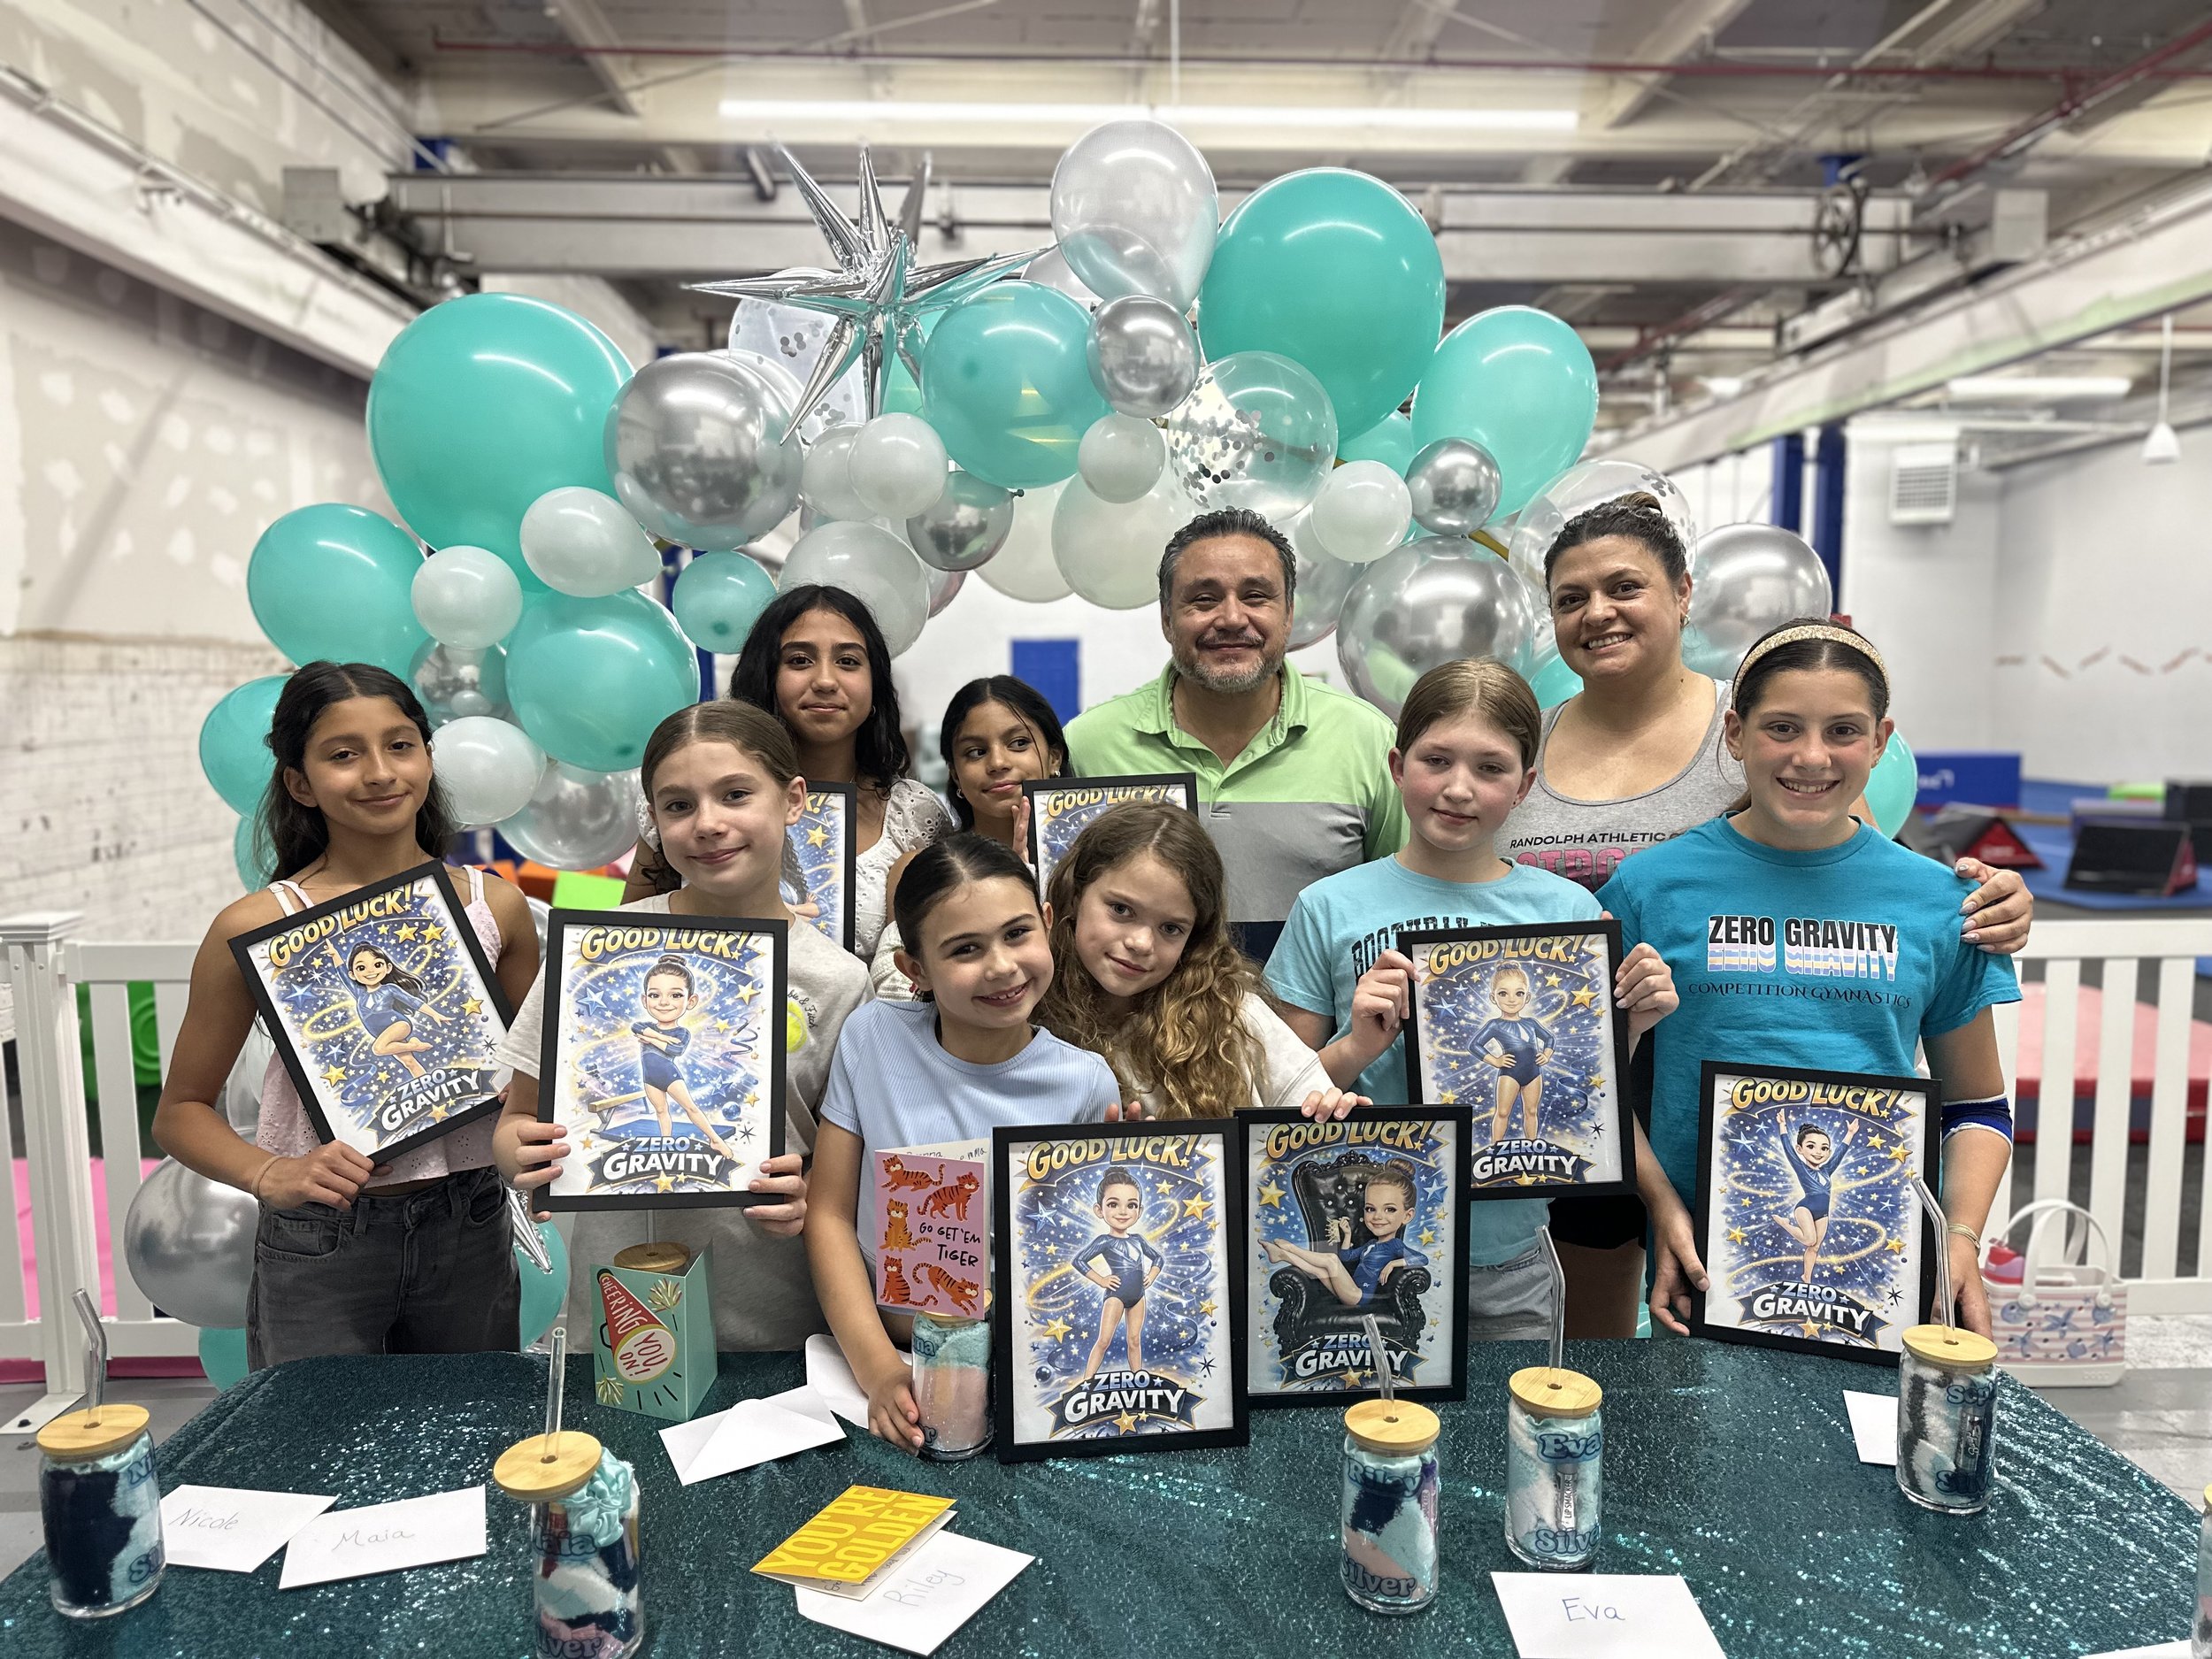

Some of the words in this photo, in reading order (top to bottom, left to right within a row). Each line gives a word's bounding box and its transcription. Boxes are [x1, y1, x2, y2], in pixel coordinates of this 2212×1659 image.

[1048, 787, 1105, 818] GOOD
[1509, 834, 1584, 849] RANDOLPH
[1587, 832, 1666, 843] ATHLETIC
[269, 914, 337, 969] GOOD
[339, 882, 414, 933] LUCK!
[1709, 915, 1776, 949] ZERO
[1785, 918, 1897, 955] GRAVITY
[580, 926, 663, 961] GOOD
[664, 927, 751, 960] LUCK!
[1429, 939, 1502, 976] GOOD
[1503, 935, 1585, 963] LUCK!
[1688, 982, 1807, 1001] COMPETITION
[1810, 987, 1912, 1009] GYMNASTICS
[396, 1068, 447, 1102] ZERO
[1732, 1077, 1810, 1110] GOOD
[1811, 1081, 1902, 1117] LUCK!
[380, 1070, 480, 1132] GRAVITY
[634, 1136, 691, 1152] ZERO
[1266, 1122, 1346, 1161] GOOD
[1347, 1121, 1434, 1151] LUCK!
[1495, 1139, 1548, 1156] ZERO
[603, 1152, 724, 1181] GRAVITY
[1027, 1137, 1109, 1182] GOOD
[1110, 1134, 1201, 1168] LUCK!
[1472, 1155, 1578, 1180] GRAVITY
[919, 1222, 933, 1234] GO
[937, 1226, 959, 1242] GET
[937, 1243, 979, 1267] TIGER
[1780, 1281, 1837, 1303] ZERO
[1752, 1293, 1872, 1332] GRAVITY
[619, 1352, 651, 1377] ON!
[634, 1332, 668, 1368] YOU
[1294, 1349, 1409, 1377] GRAVIY
[1093, 1370, 1150, 1392] ZERO
[1064, 1388, 1186, 1424] GRAVITY
[1540, 1432, 1601, 1460] Eva
[168, 1508, 240, 1530] Nicole
[757, 1487, 899, 1570] YOU'RE
[331, 1528, 415, 1552] Maia
[816, 1494, 950, 1579] GOLDEN
[883, 1570, 965, 1607] Riley
[1562, 1597, 1625, 1622] Eva
